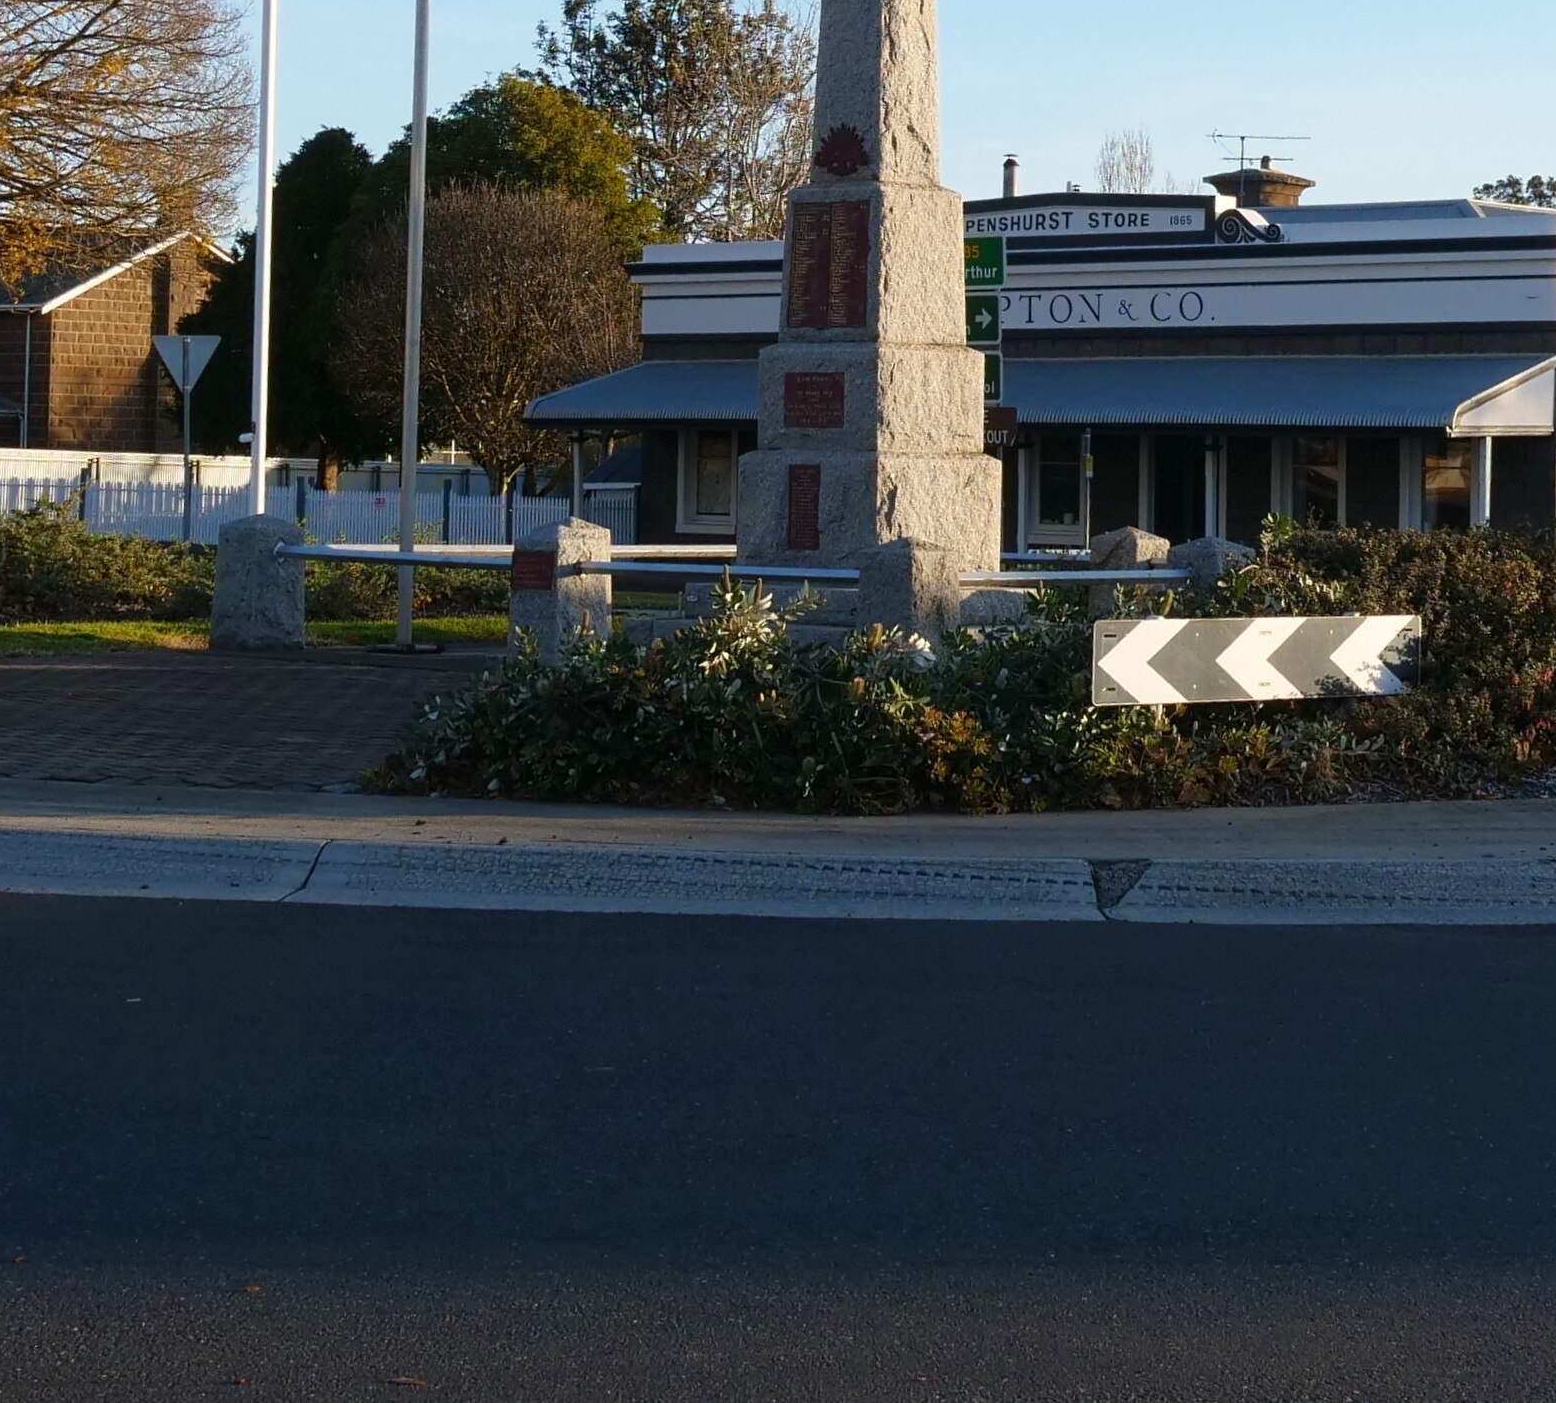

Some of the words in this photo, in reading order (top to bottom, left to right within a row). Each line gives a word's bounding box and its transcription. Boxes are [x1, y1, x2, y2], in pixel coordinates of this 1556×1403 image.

[965, 211, 1073, 233] PENSHURST
[1088, 212, 1150, 229] STORE
[1169, 215, 1192, 226] 1865
[964, 244, 980, 258] 85
[965, 265, 998, 278] rthur
[1118, 299, 1140, 321] &
[1150, 291, 1215, 322] CO.
